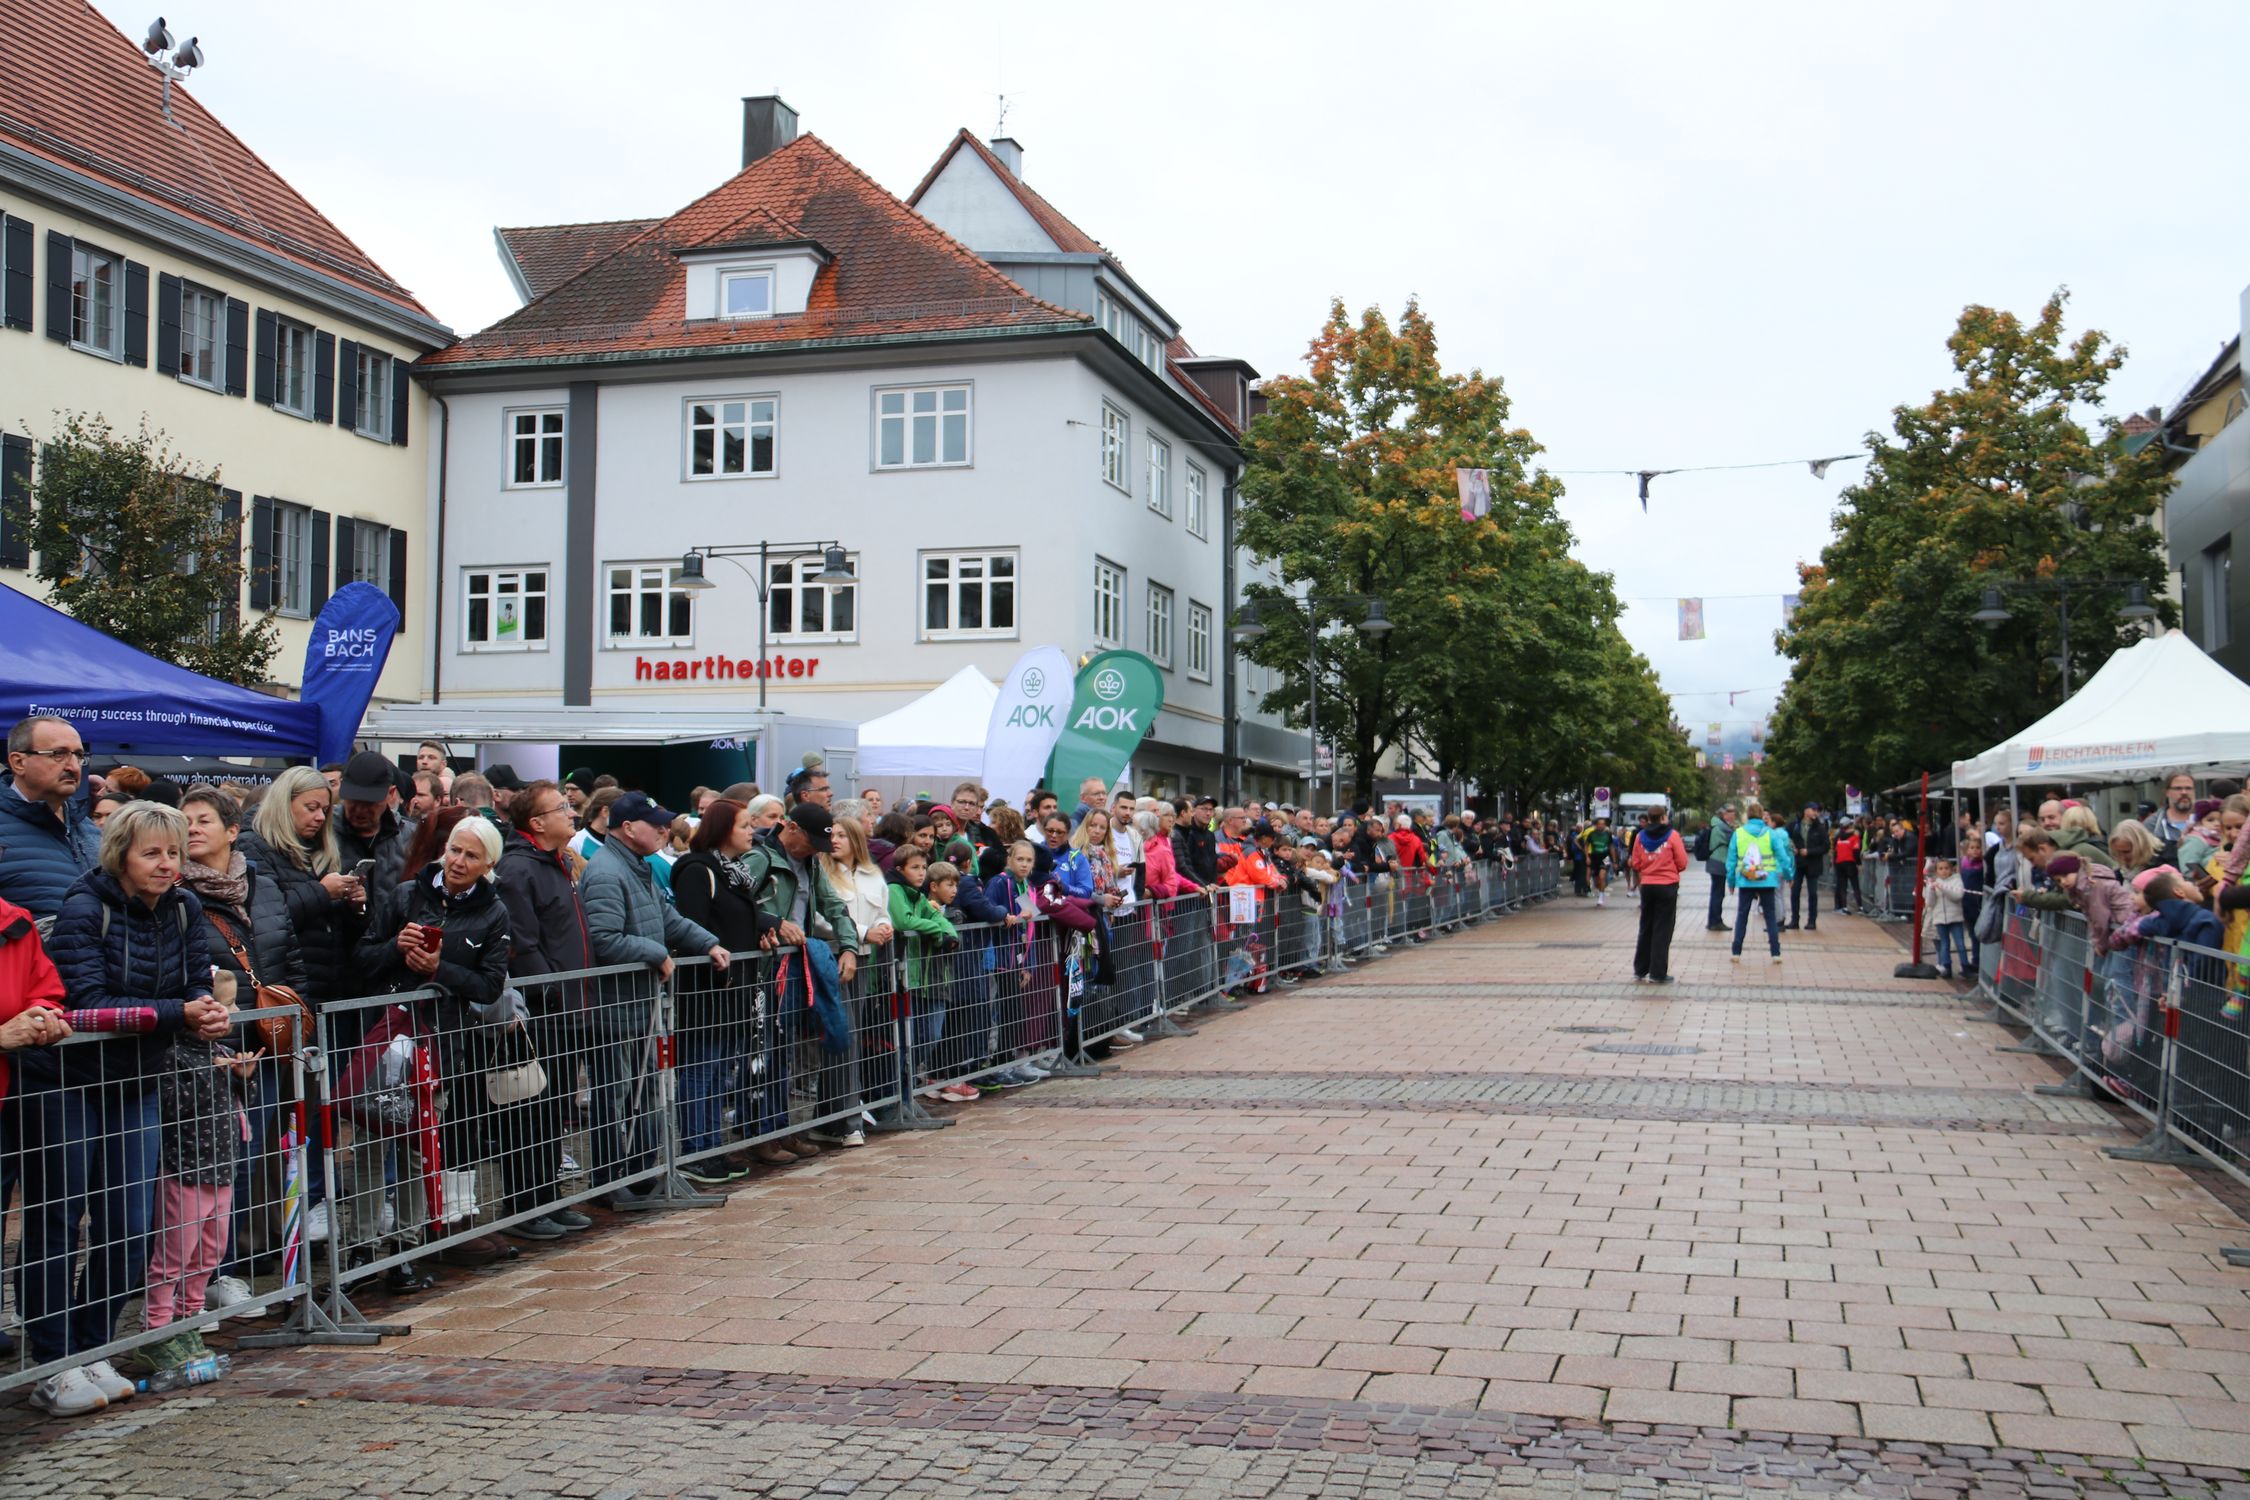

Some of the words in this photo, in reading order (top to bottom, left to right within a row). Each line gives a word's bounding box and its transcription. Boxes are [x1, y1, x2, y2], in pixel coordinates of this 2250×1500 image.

[328, 628, 377, 643] BANS
[324, 643, 375, 658] BACH
[635, 654, 819, 681] haartheater
[28, 703, 98, 722] Empowering
[101, 709, 143, 721] success
[145, 709, 187, 726] through
[189, 712, 232, 728] financial
[232, 720, 276, 734] expertise.
[1006, 704, 1055, 729] AOK
[1073, 706, 1139, 732] AOK
[710, 738, 735, 750] AOK
[2045, 742, 2157, 761] LEICHTATHLETIK
